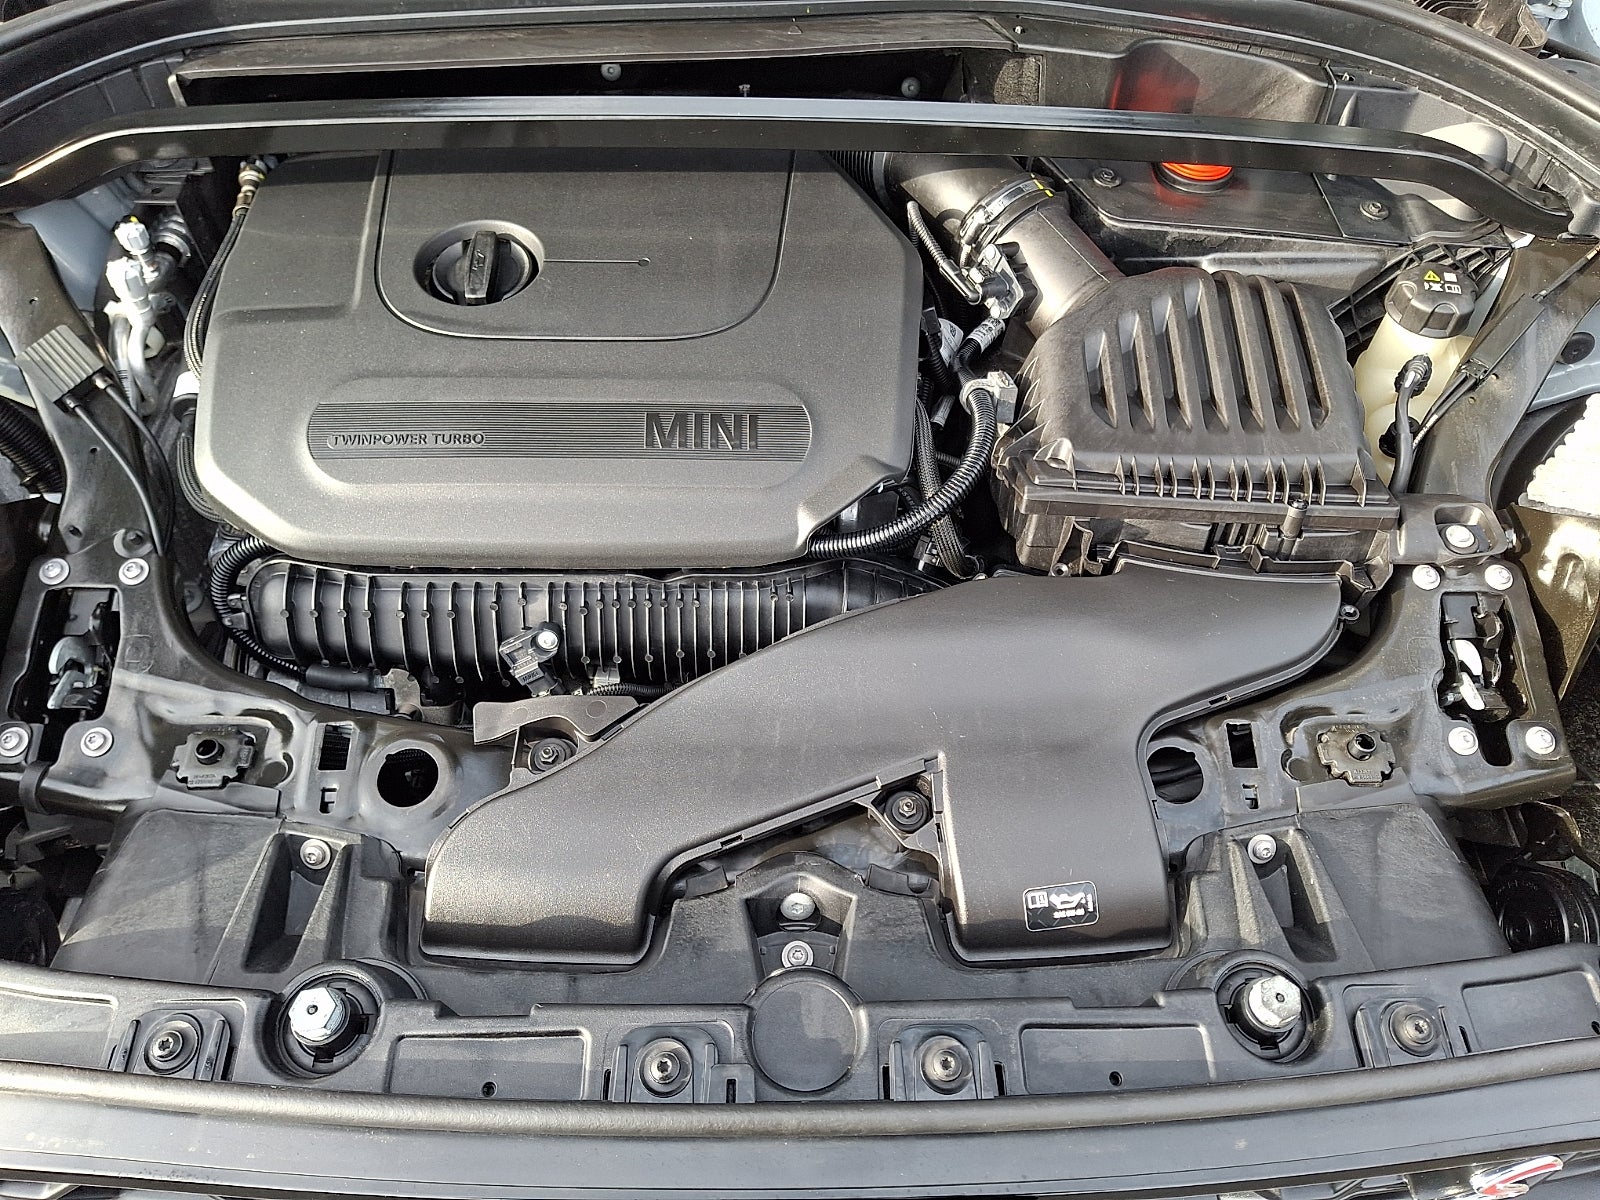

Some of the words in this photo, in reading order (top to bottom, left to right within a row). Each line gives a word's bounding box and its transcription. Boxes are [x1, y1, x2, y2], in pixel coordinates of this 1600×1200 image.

[330, 433, 427, 446] TWINPOWER
[431, 432, 484, 445] TURBO
[644, 411, 758, 450] MINI
